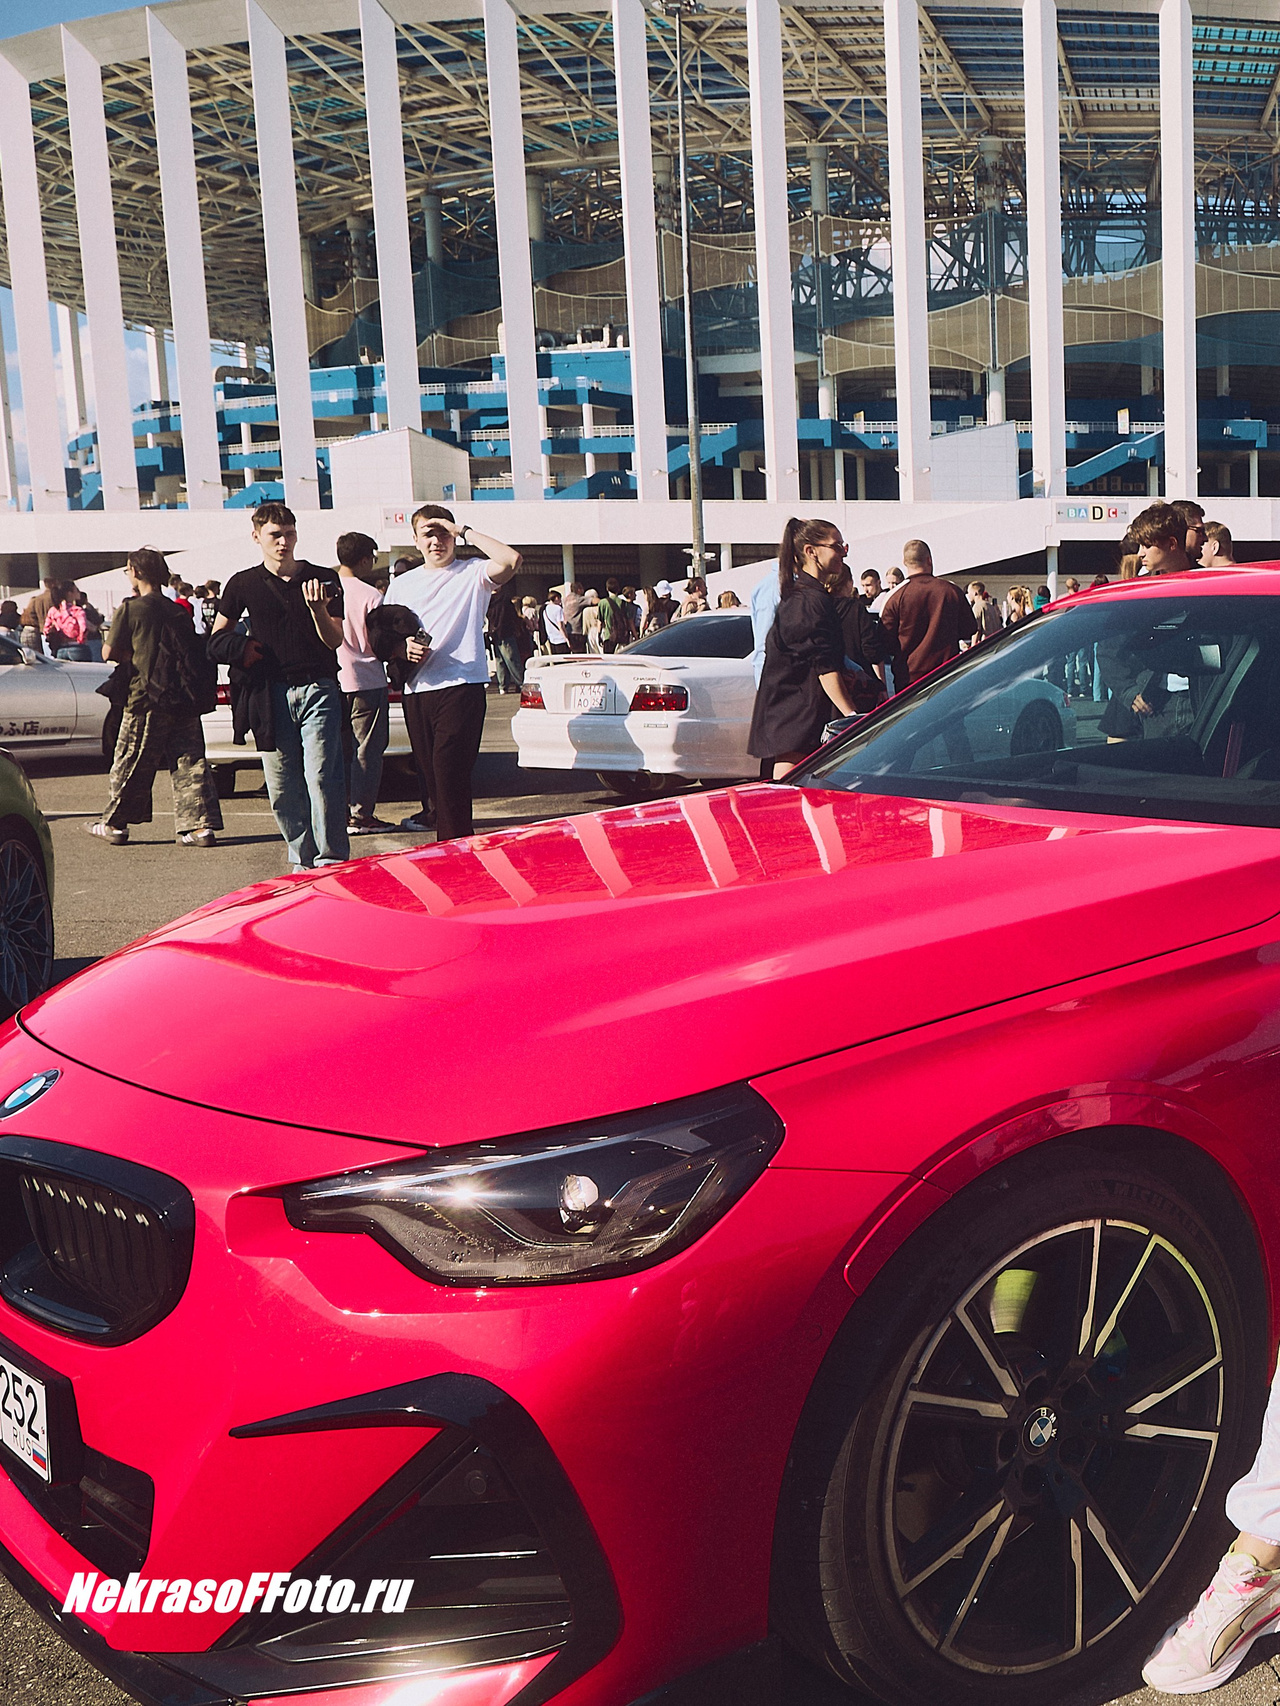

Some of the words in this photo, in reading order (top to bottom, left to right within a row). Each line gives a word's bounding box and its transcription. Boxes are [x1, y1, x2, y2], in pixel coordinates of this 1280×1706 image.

[1068, 508, 1076, 517] B
[1079, 508, 1087, 517] A
[1092, 506, 1103, 520] D
[1109, 508, 1117, 517] C
[0, 1365, 39, 1441] 252
[12, 1426, 32, 1456] RUS
